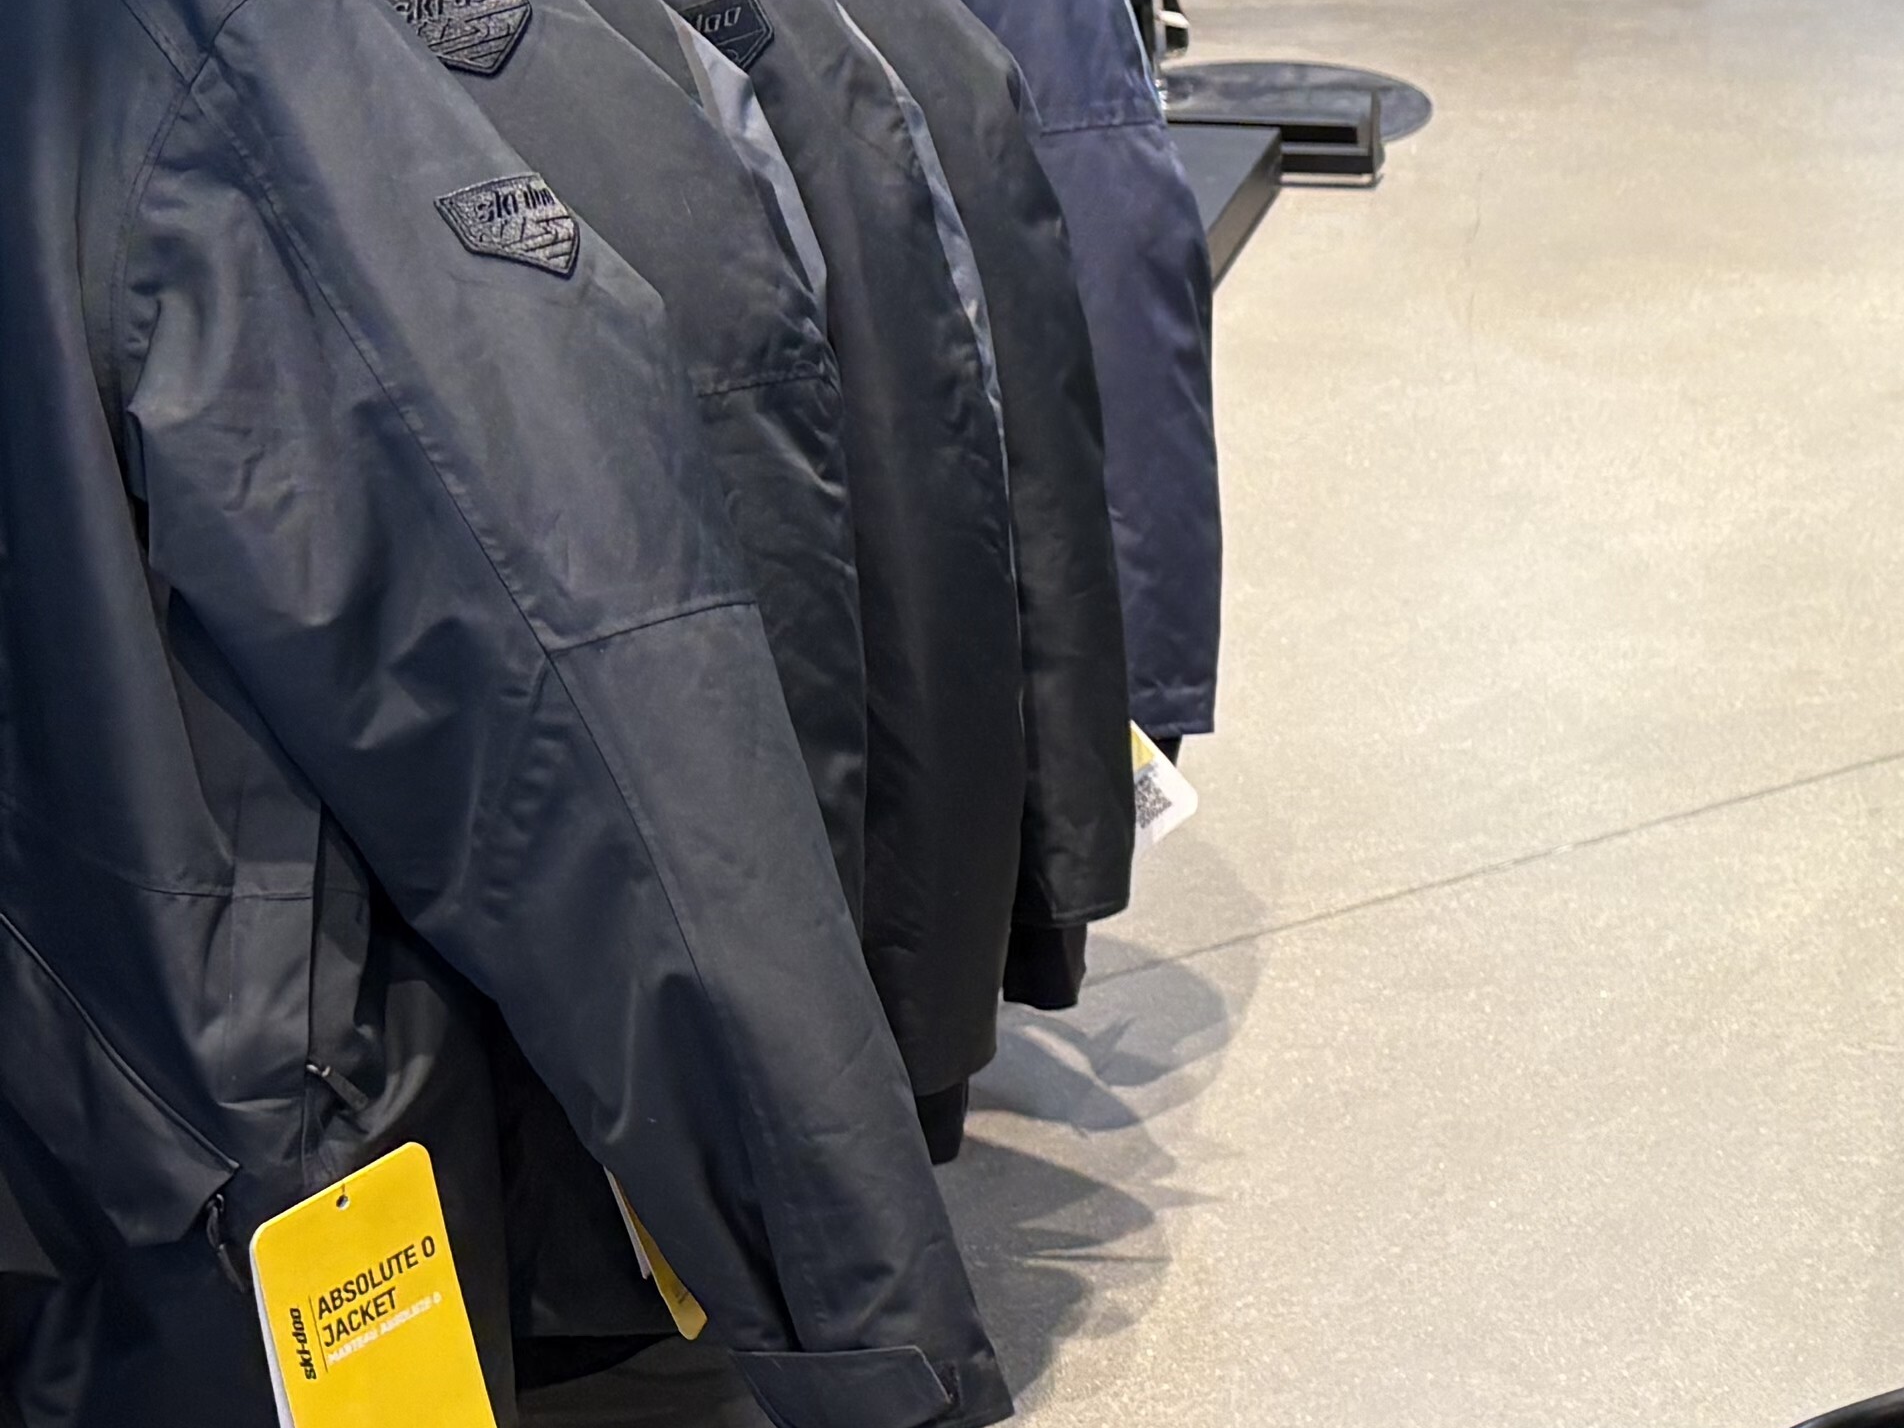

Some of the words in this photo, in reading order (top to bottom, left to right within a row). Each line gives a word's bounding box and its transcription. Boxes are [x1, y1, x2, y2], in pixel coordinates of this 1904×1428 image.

[317, 1244, 419, 1320] ABSOLUTE
[322, 1286, 397, 1348] JACKET
[290, 1306, 318, 1381] ski-doo
